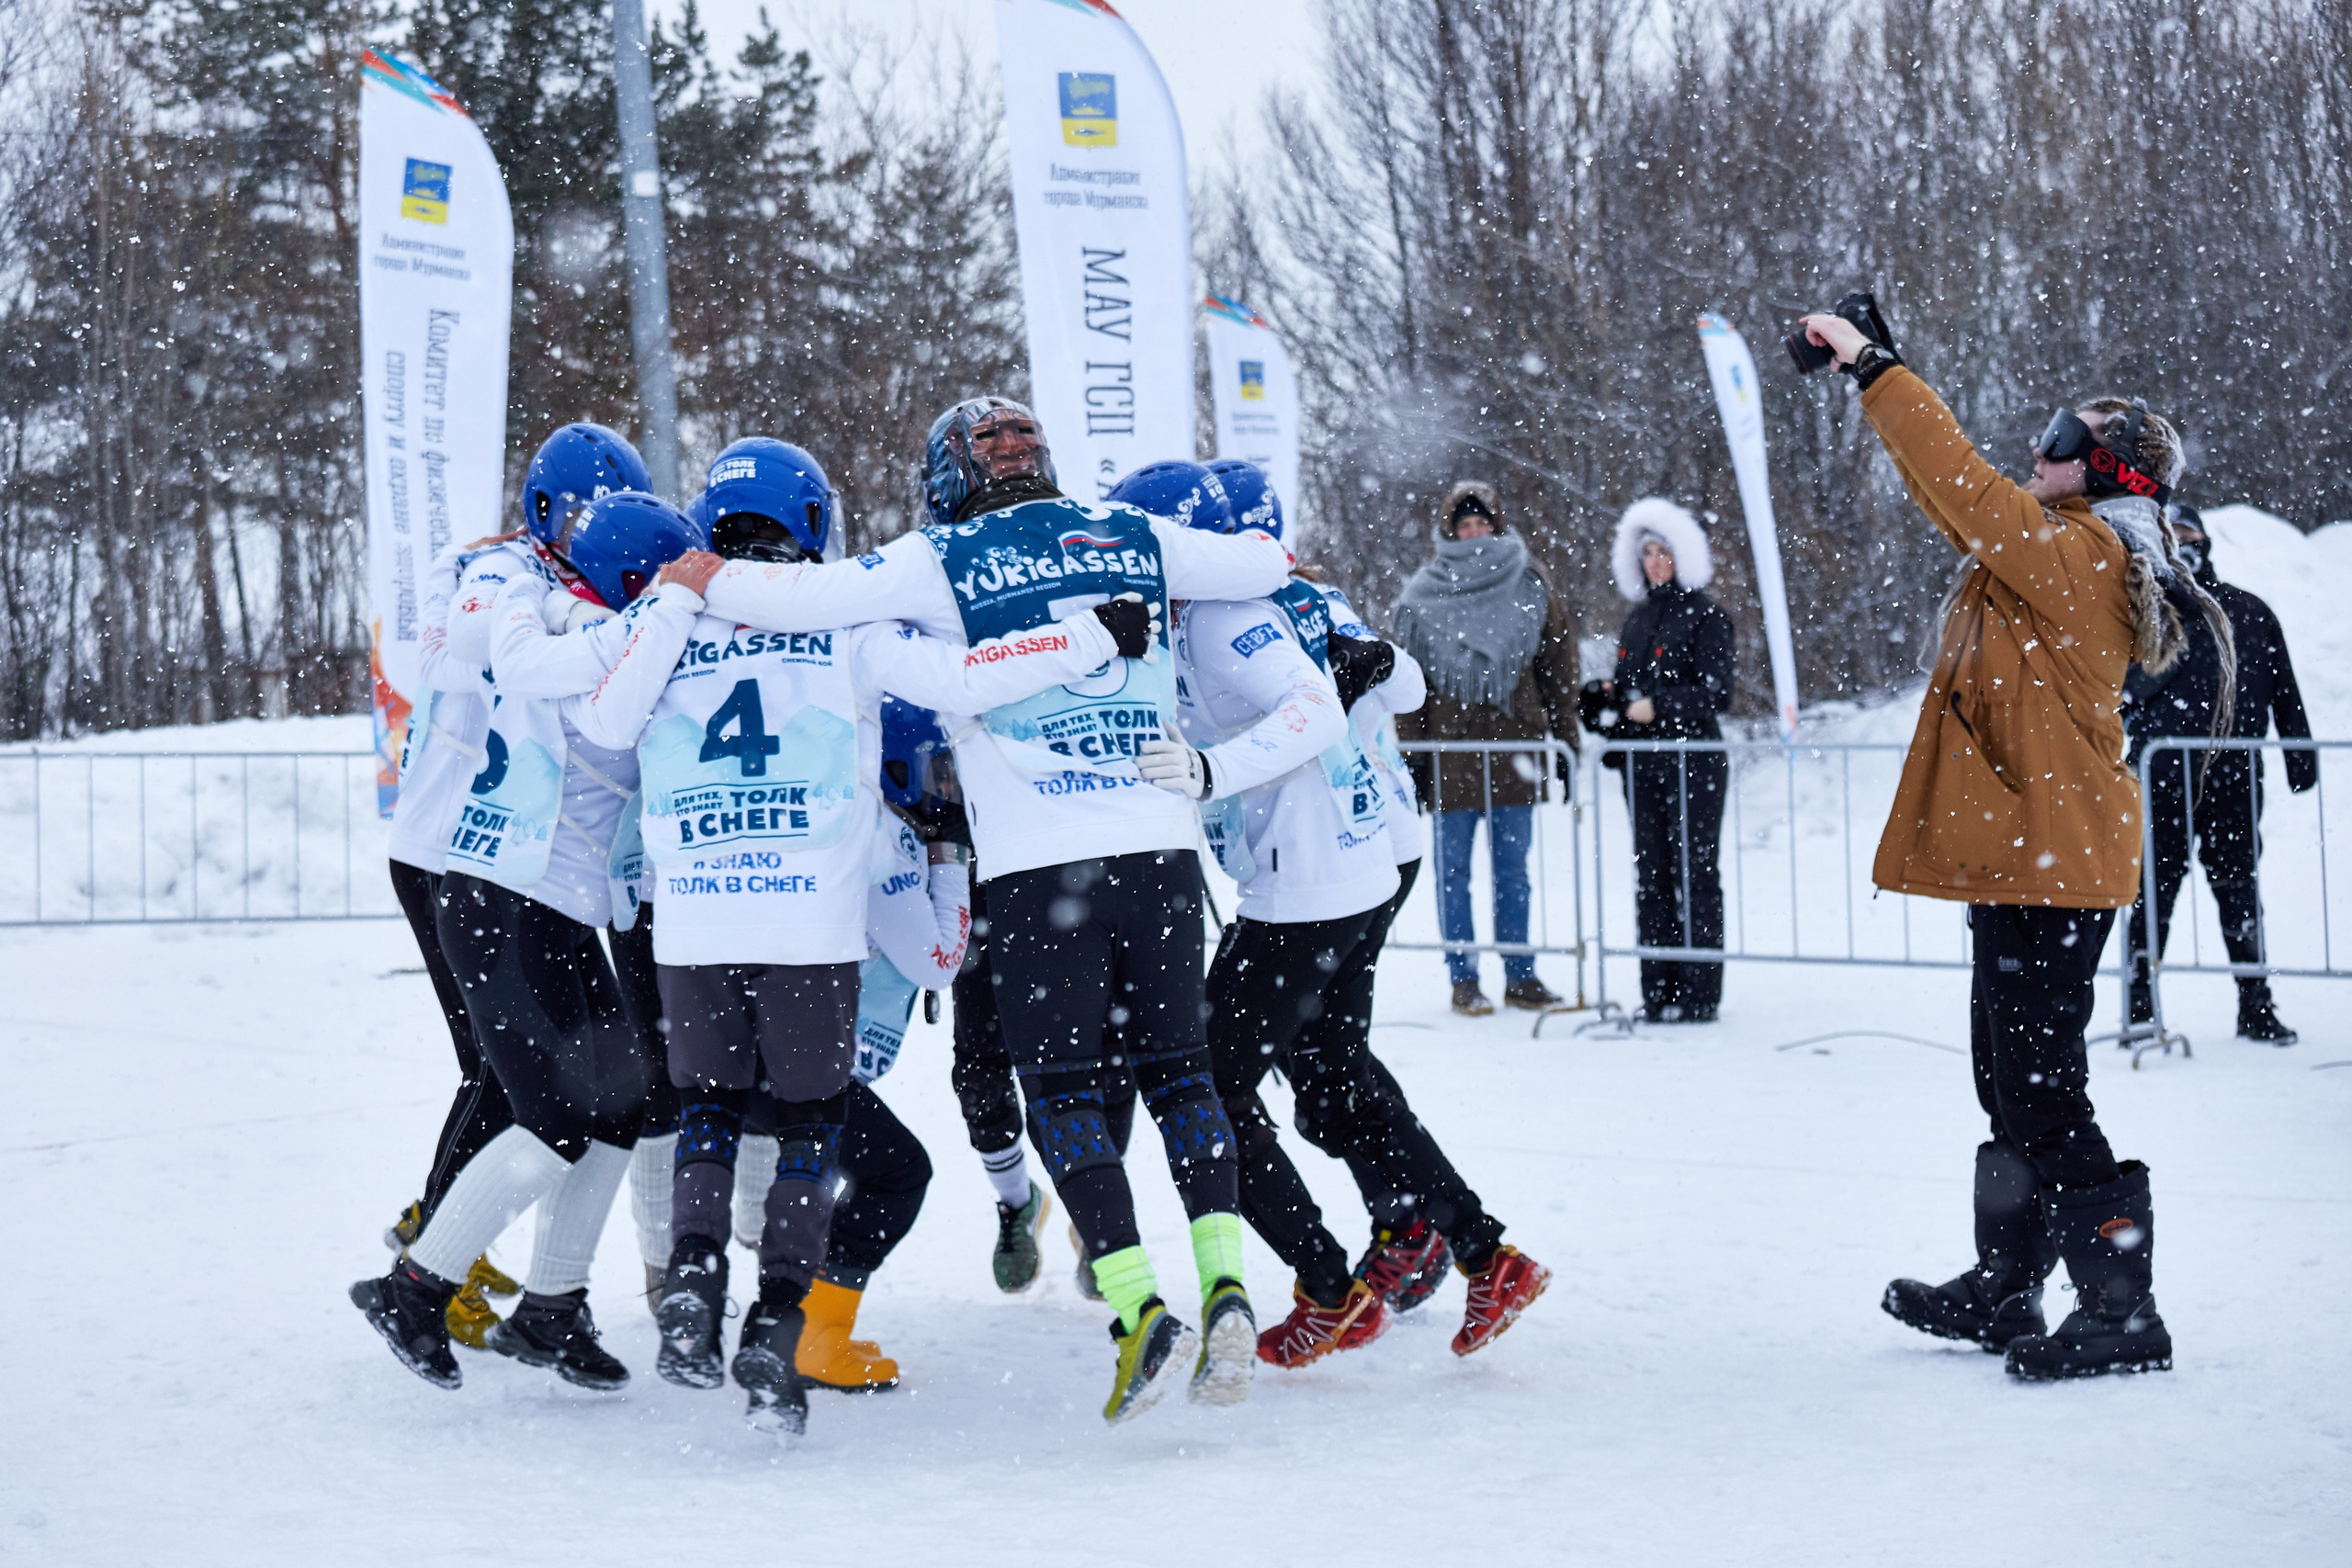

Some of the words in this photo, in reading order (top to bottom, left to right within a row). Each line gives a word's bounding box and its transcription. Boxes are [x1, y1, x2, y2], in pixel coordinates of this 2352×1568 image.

[1082, 246, 1133, 344] МАУ
[424, 309, 459, 411] Комитет
[382, 350, 406, 427] спорту
[388, 435, 406, 449] и
[726, 460, 756, 469] ТОЛК
[717, 468, 756, 483] СНЕГЕ
[388, 457, 411, 535] охране
[997, 587, 1035, 603] MURMANSK
[1035, 581, 1062, 591] REGION
[966, 635, 1068, 667] KIGASSEN
[691, 669, 717, 678] REGION
[699, 678, 781, 777] 4
[1042, 718, 1068, 733] ДЛЯ
[1099, 710, 1160, 729] ТОЛК
[1045, 732, 1065, 740] КТО
[1067, 723, 1098, 737] ЗНАЕТ
[674, 795, 695, 808] ДЛЯ
[697, 791, 723, 802] ТЕХ,
[729, 787, 808, 808] ТОЛК
[692, 802, 723, 813] ЗНАЕТ
[461, 806, 511, 832] ТОЛК
[680, 819, 694, 843] В
[698, 808, 809, 838] СНЕГЕ
[451, 827, 503, 858] ЕГЕ
[711, 852, 782, 870] ЗНАЮ
[669, 875, 721, 895] ТОЛК
[726, 876, 742, 894] В
[747, 875, 817, 894] СНЕГЕ
[862, 1036, 876, 1046] КТО
[865, 1028, 885, 1040] ДЛЯ
[861, 1050, 873, 1070] В
